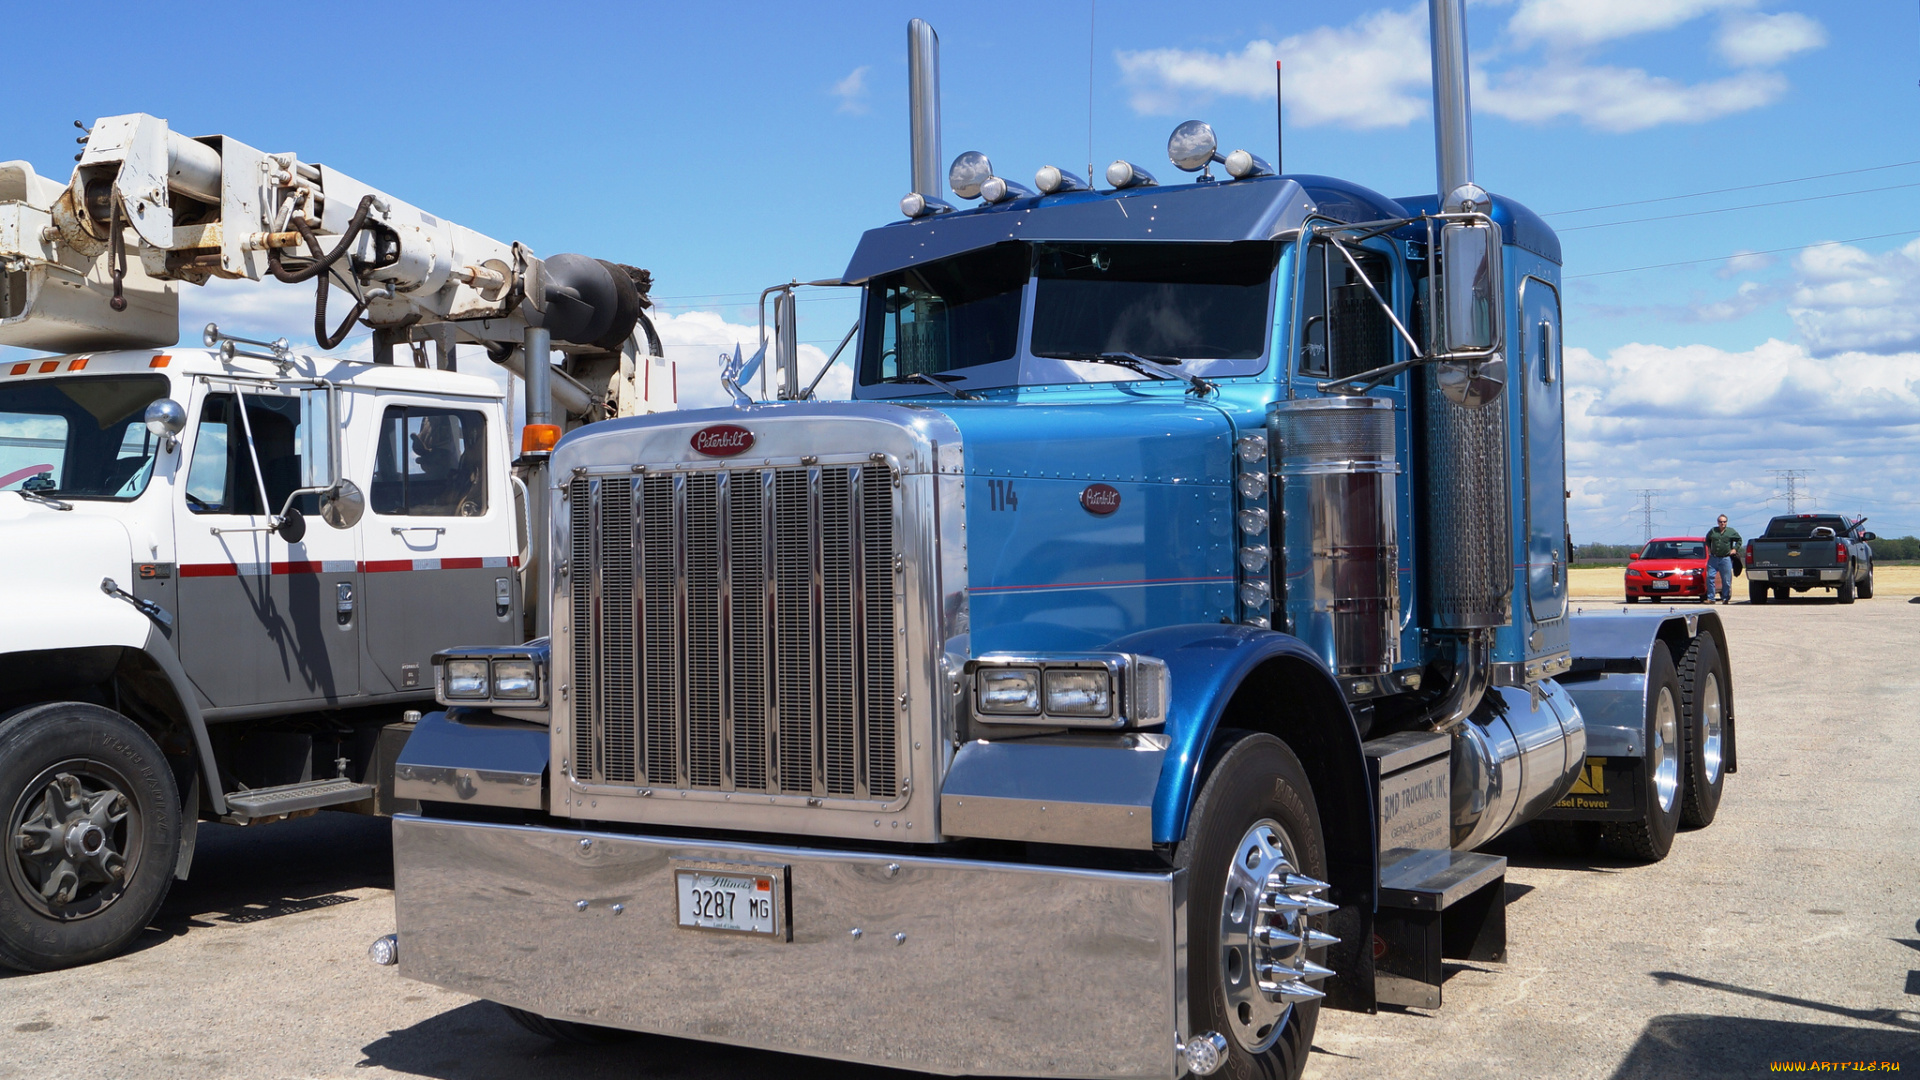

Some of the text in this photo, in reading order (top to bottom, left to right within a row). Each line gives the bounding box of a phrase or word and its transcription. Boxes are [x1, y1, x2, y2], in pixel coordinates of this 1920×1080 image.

[697, 431, 748, 450] Peterbilt
[988, 480, 1018, 511] 114
[1086, 488, 1118, 506] Peterbilt
[1577, 797, 1609, 808] Power
[700, 875, 751, 890] Illinois
[692, 889, 769, 920] 3287 MG
